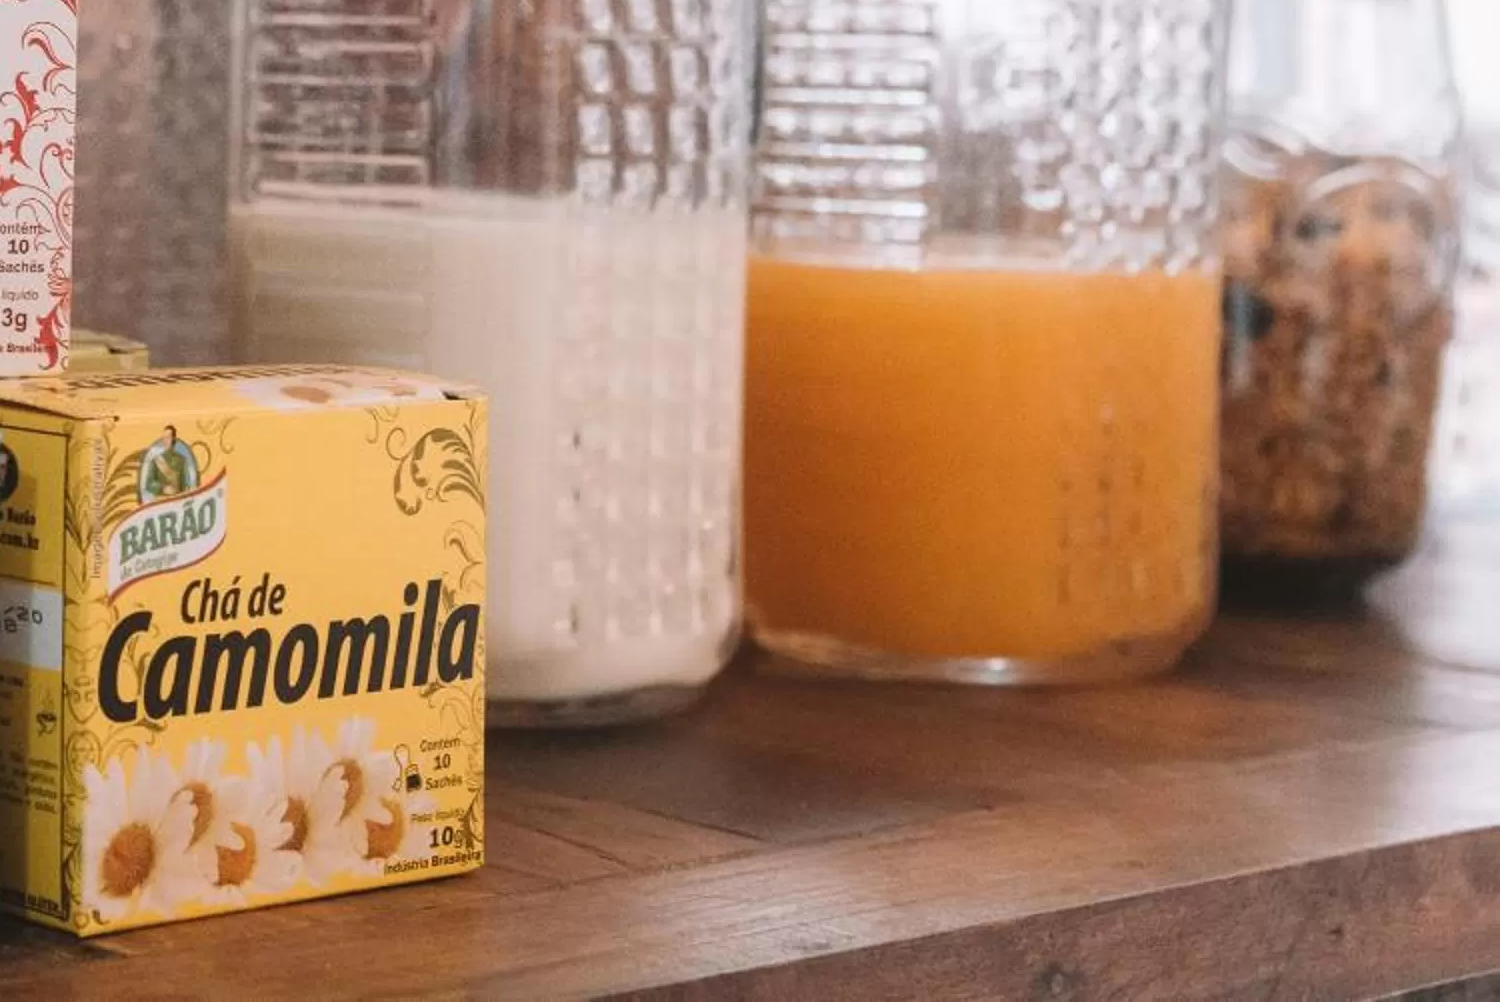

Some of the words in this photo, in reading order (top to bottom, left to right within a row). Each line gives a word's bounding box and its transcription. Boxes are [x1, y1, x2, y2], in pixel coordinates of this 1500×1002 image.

[7, 239, 30, 255] 10
[119, 497, 218, 566] BARÃO
[180, 575, 242, 625] Chá
[247, 572, 287, 618] de
[96, 578, 481, 723] Camomila
[432, 753, 452, 771] 10
[428, 825, 465, 850] 10g
